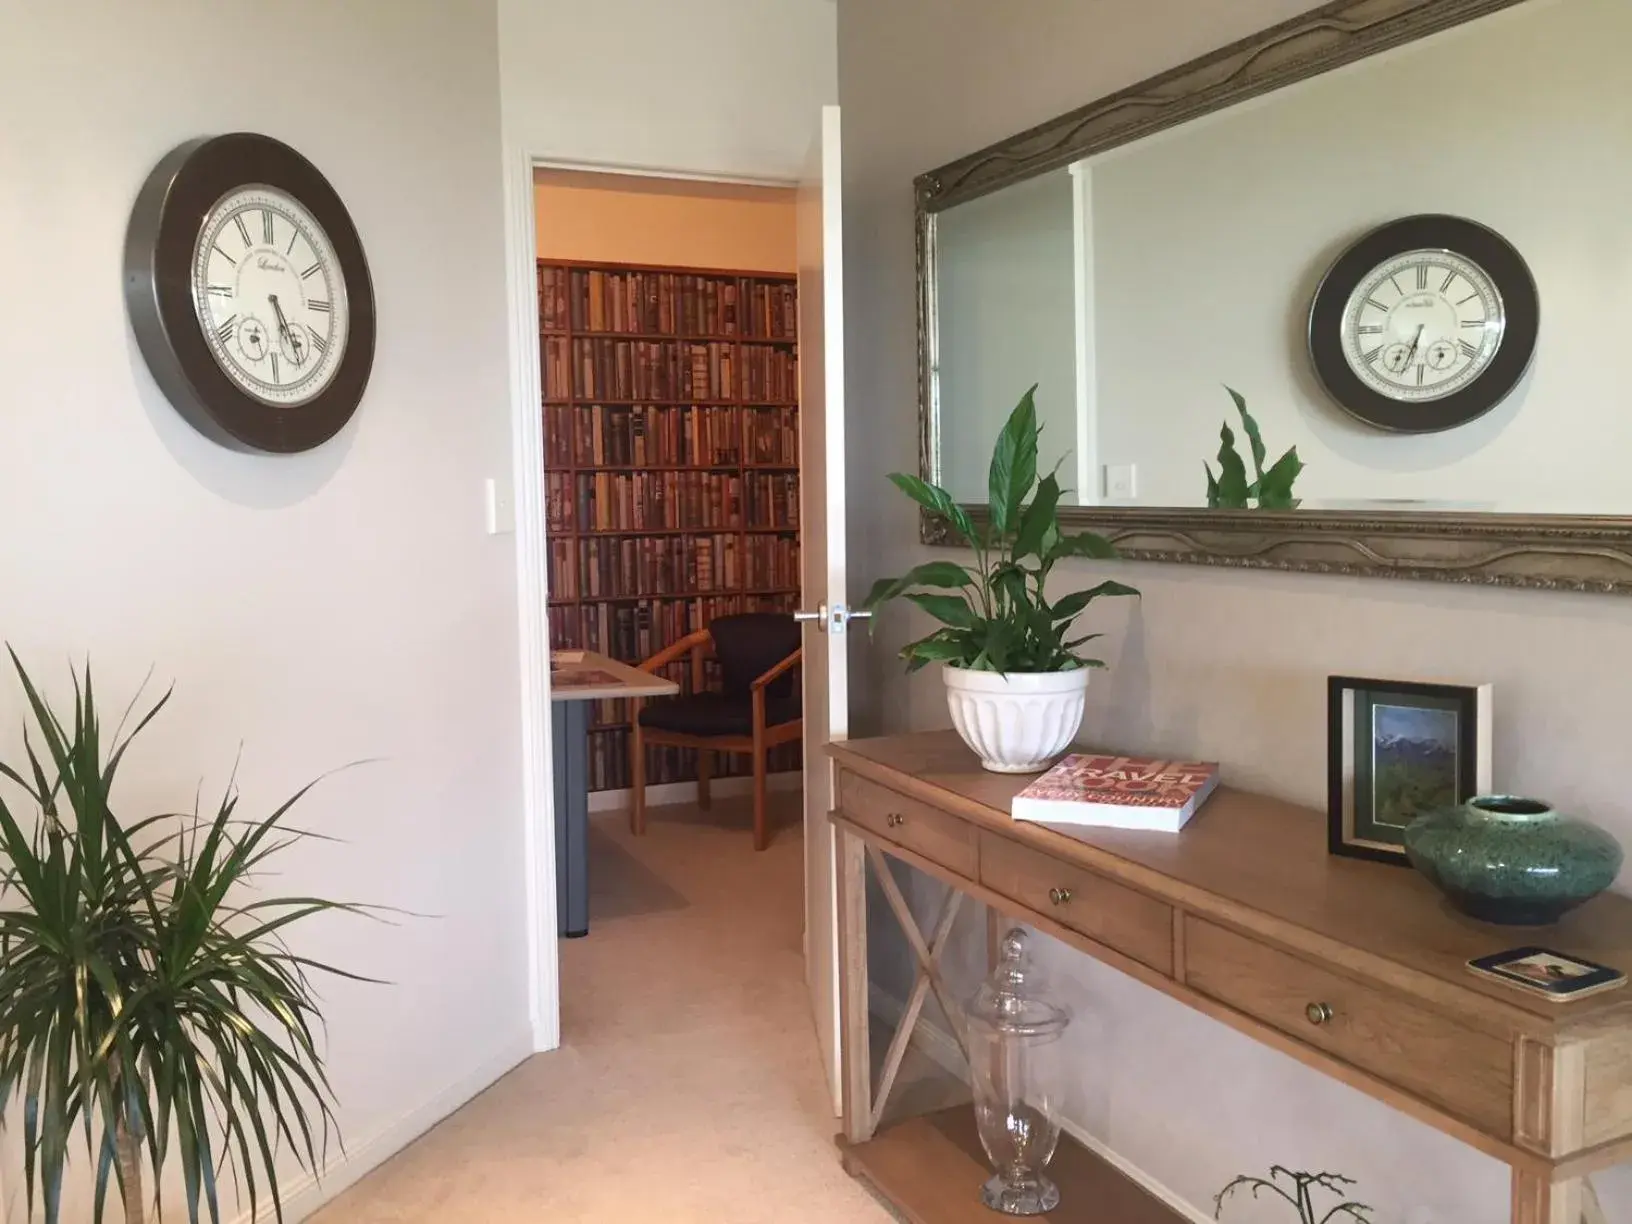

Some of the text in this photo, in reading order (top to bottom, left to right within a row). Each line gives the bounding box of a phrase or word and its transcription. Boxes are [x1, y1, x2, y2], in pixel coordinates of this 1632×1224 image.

[1072, 753, 1211, 777] THE
[1055, 766, 1204, 785] TRAVEL
[1038, 775, 1195, 797] BOOK
[1087, 792, 1187, 804] COUNTRY
